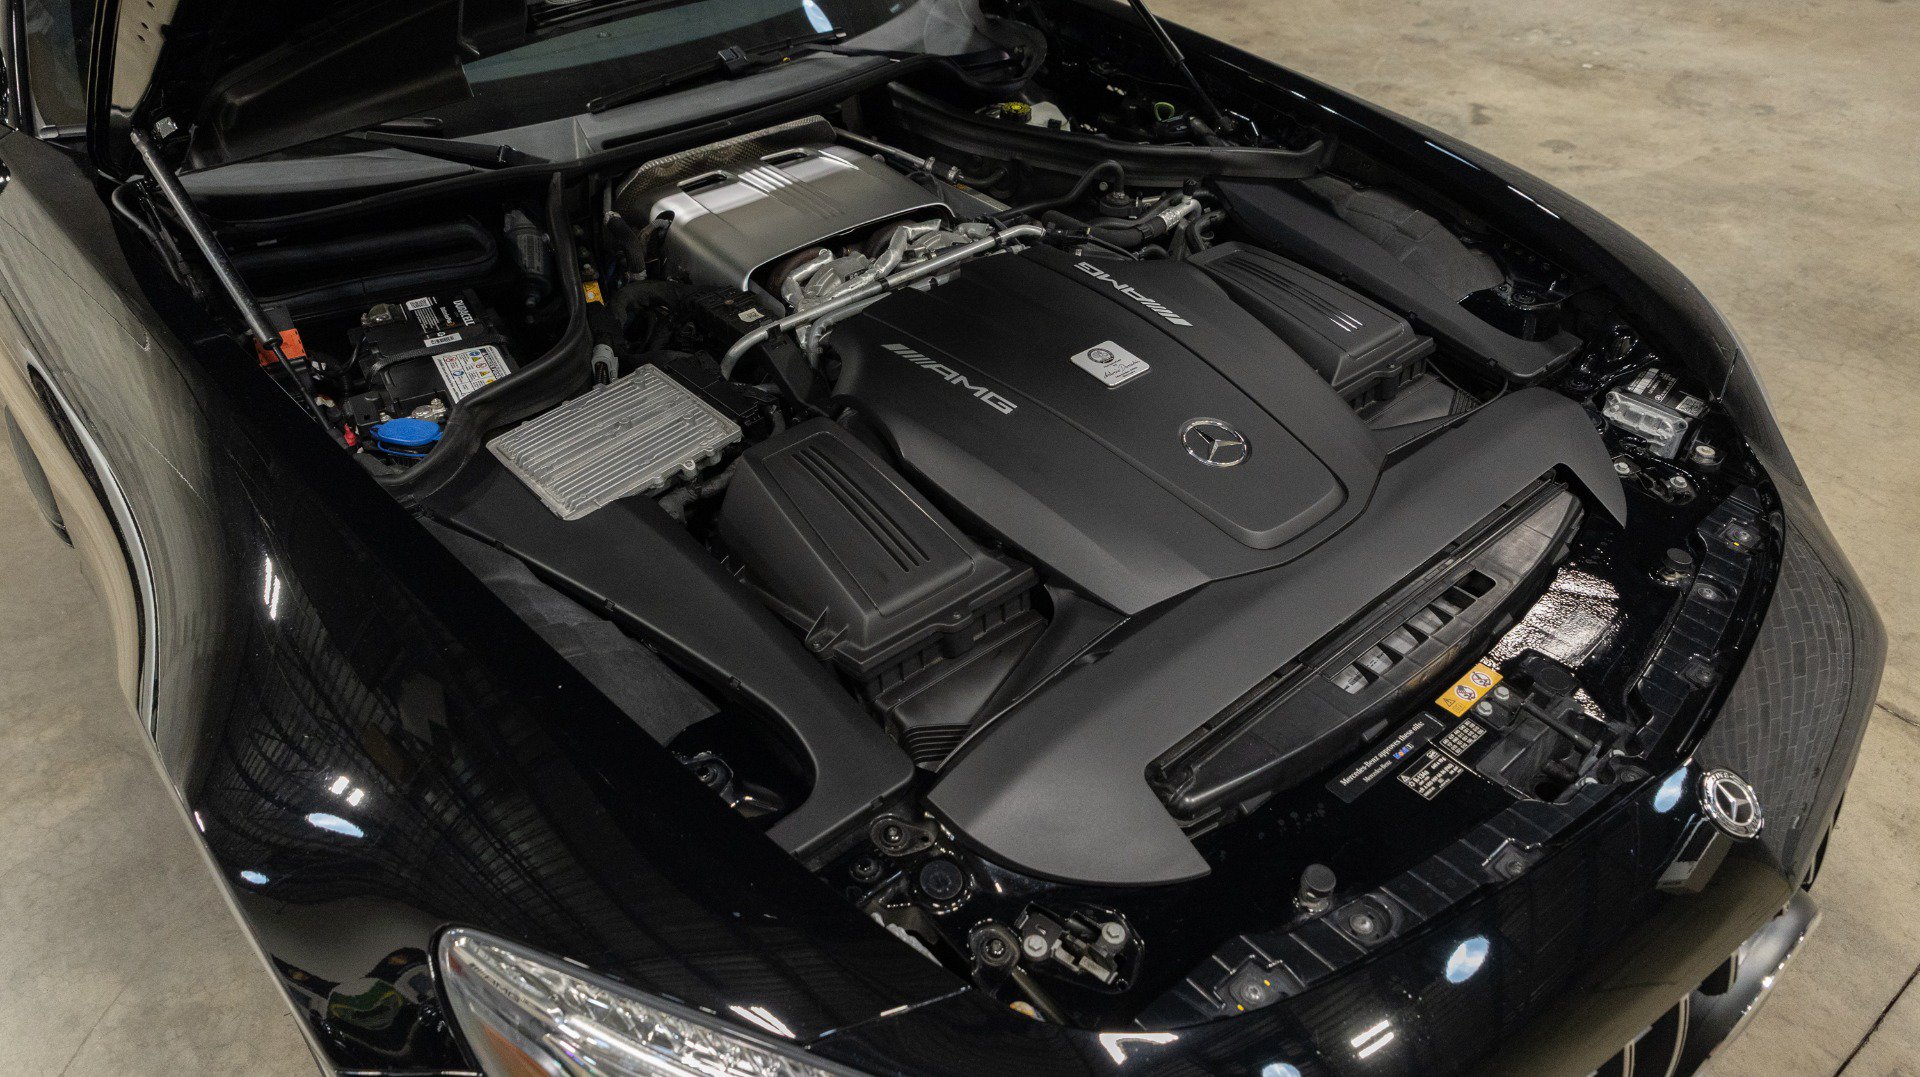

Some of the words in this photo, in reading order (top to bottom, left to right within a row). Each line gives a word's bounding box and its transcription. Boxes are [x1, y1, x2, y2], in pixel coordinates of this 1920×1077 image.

[453, 299, 475, 327] DURACELL
[1340, 755, 1379, 786] Mercedes-Benz
[1378, 740, 1401, 758] approves
[1398, 729, 1415, 741] these
